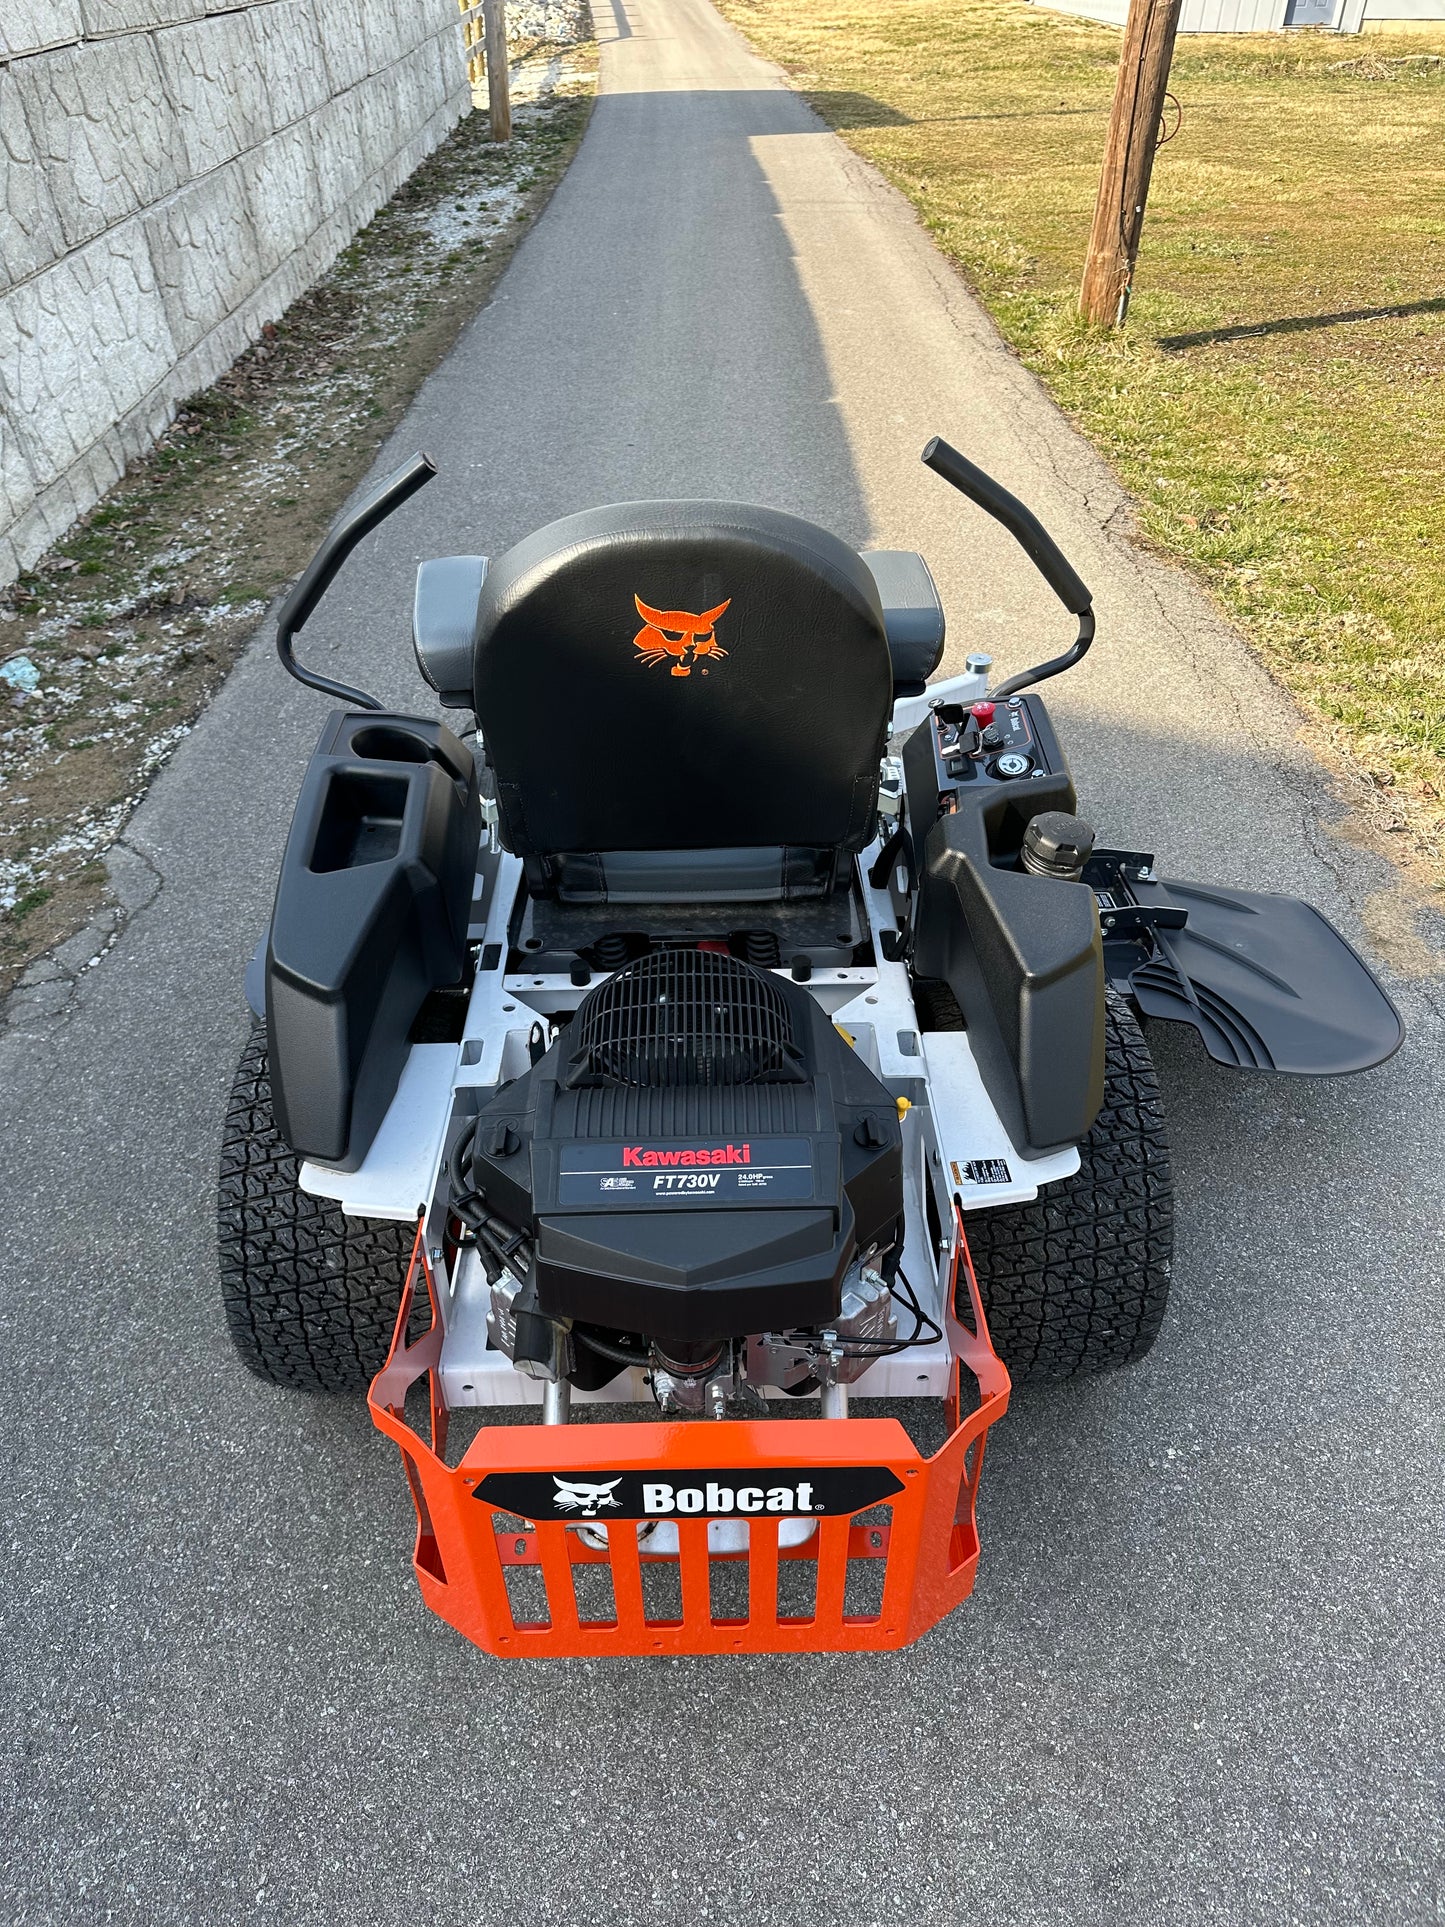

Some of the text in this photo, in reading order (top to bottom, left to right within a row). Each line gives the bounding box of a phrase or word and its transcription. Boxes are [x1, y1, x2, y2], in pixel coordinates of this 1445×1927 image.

[623, 1143, 751, 1167] Kawasaki
[653, 1173, 721, 1189] FT730V
[642, 1482, 813, 1514] Bobcat
